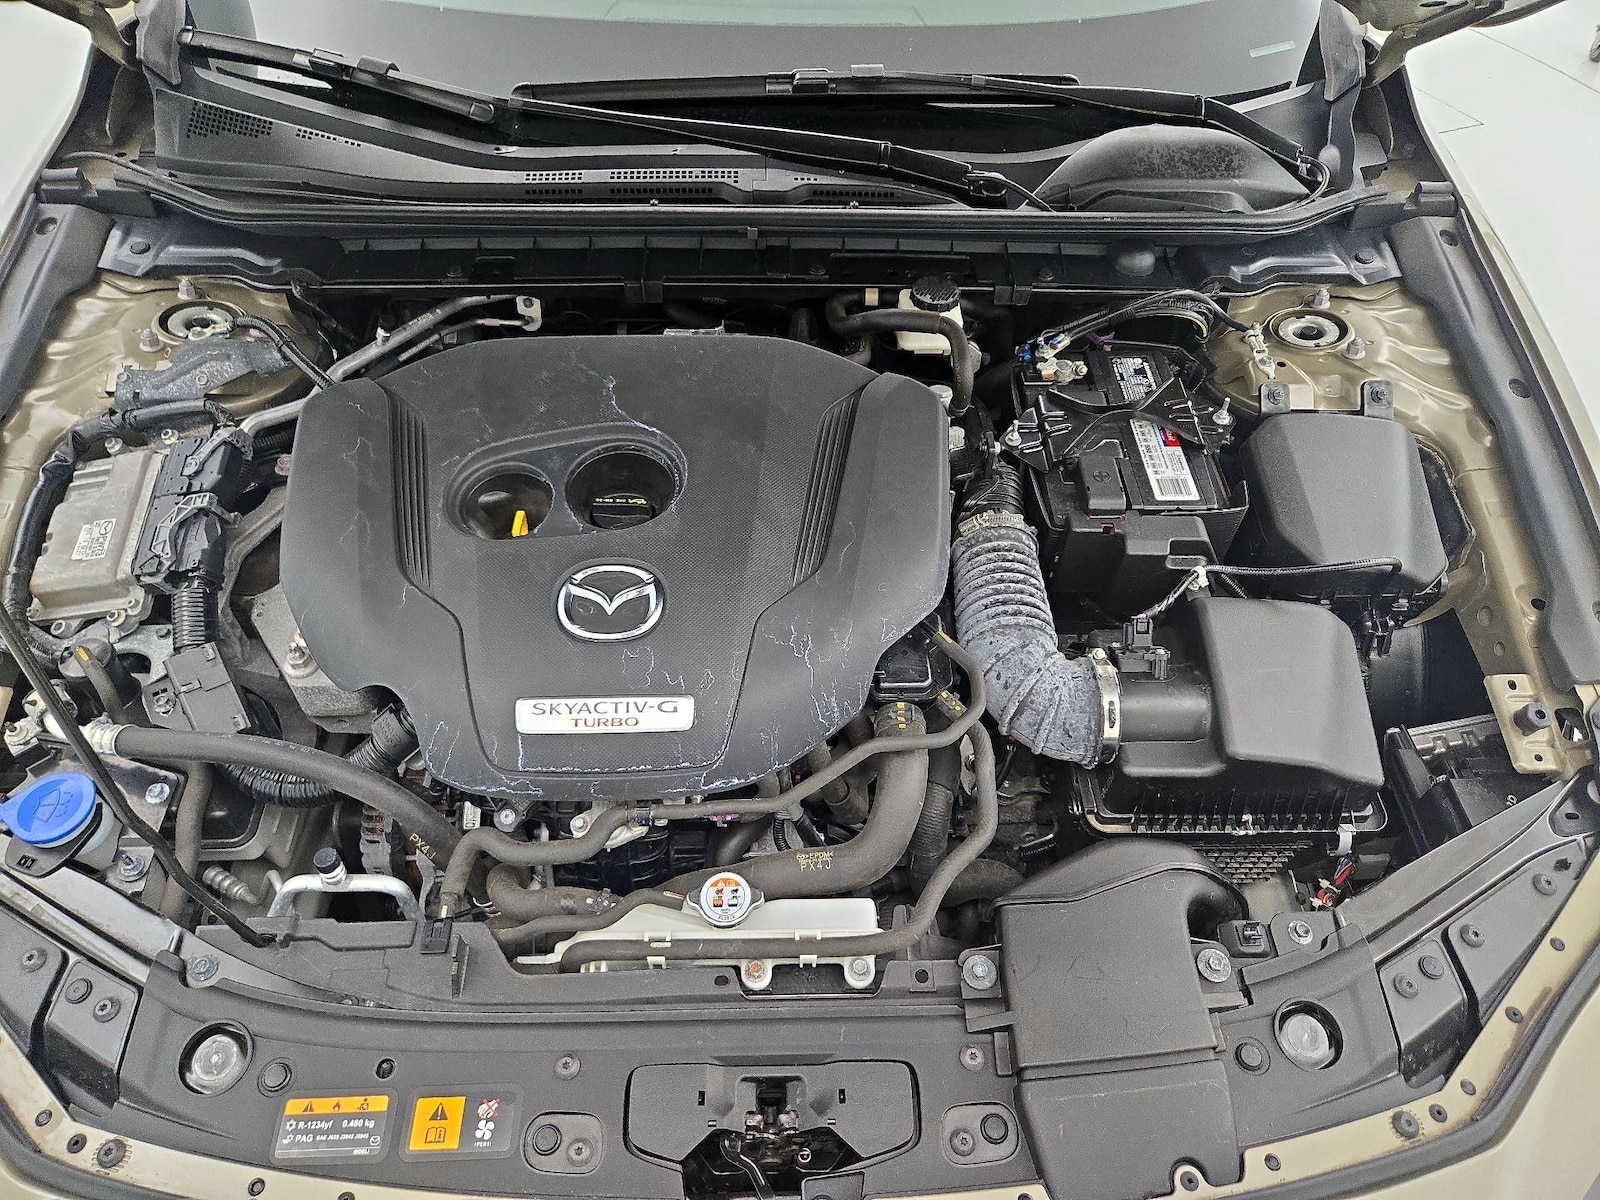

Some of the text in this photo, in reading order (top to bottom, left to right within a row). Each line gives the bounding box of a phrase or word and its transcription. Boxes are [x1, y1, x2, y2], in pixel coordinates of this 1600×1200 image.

[531, 700, 678, 716] SKYACTIV-G
[570, 717, 639, 728] TURBO
[409, 832, 437, 860] PX4J
[800, 859, 831, 872] PX4J
[364, 1119, 375, 1129] kg
[295, 1134, 313, 1143] PAG
